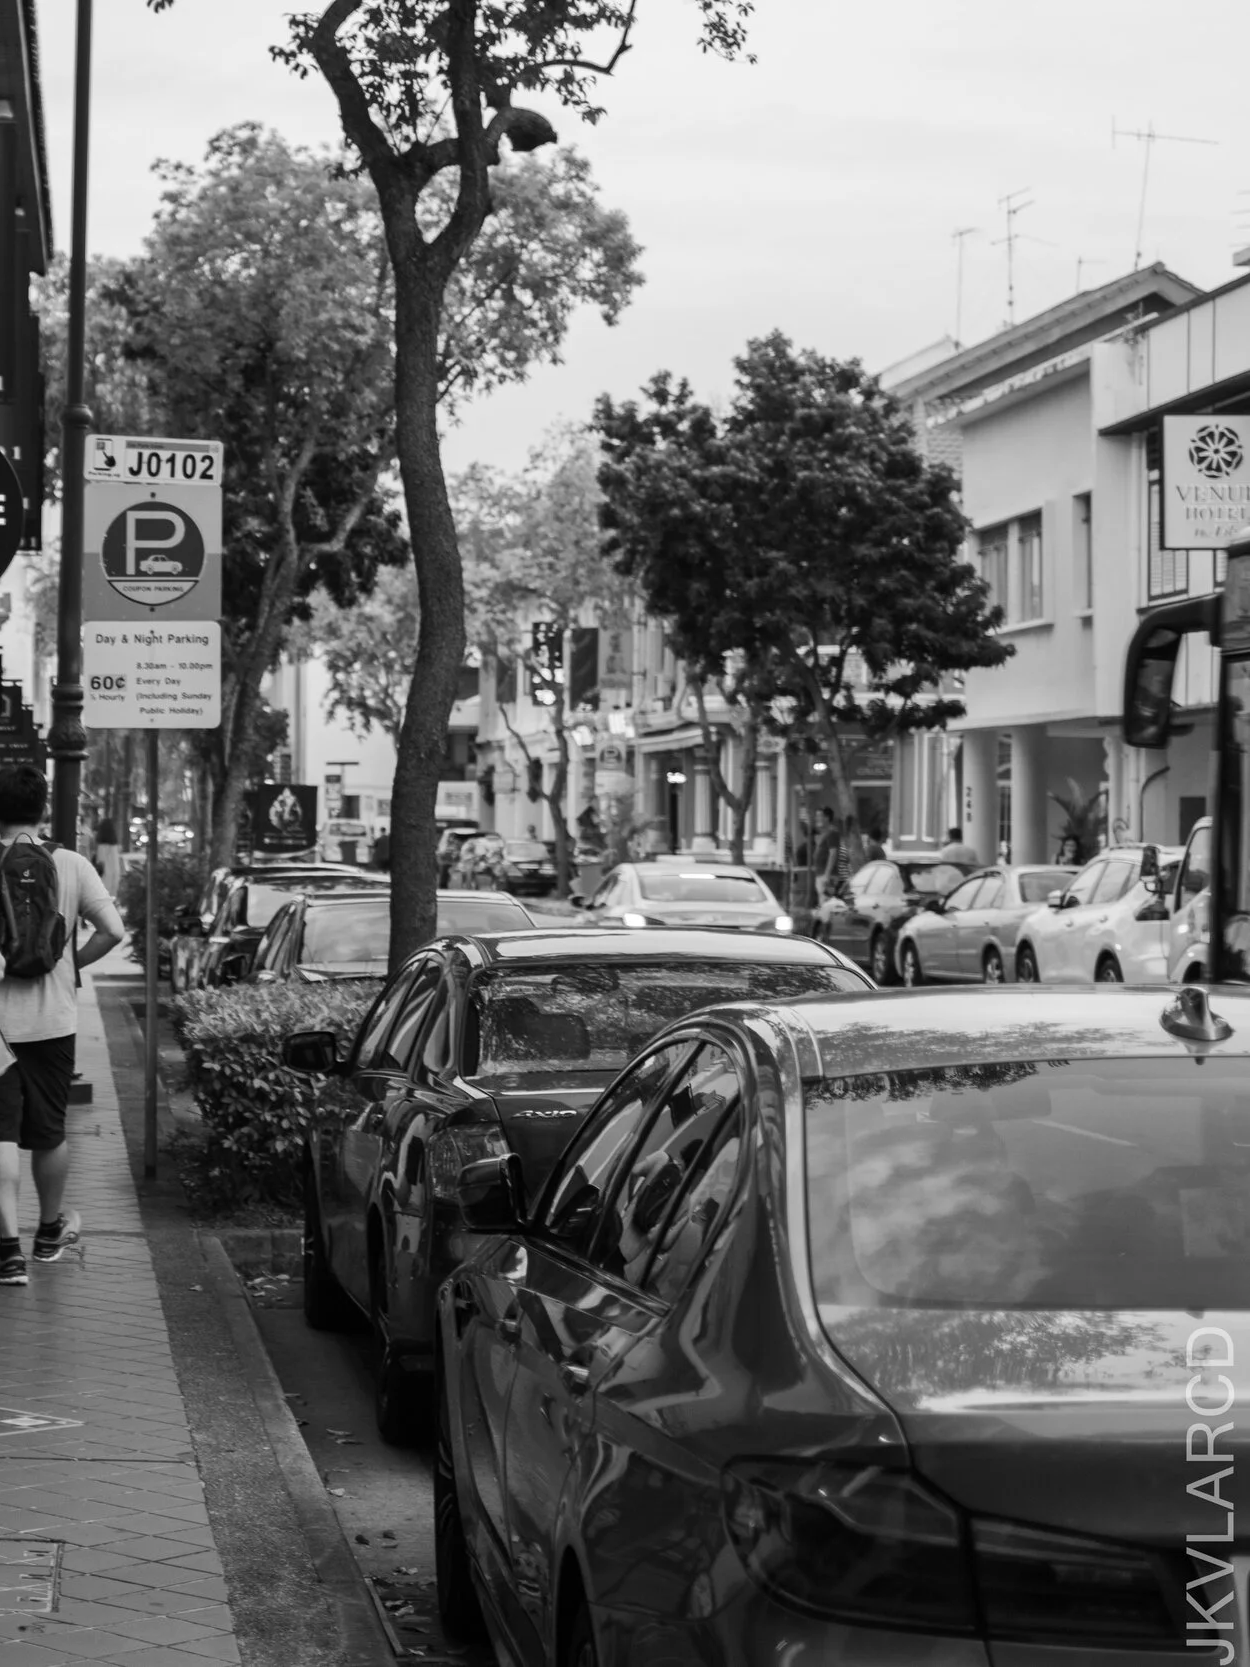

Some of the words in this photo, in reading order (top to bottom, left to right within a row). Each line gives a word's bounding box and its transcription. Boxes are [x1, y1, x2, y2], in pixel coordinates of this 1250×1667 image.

[128, 452, 215, 480] J0102
[126, 511, 185, 575] P
[96, 634, 116, 646] Day
[121, 634, 129, 644] &
[134, 634, 163, 646] Night
[168, 634, 209, 646] Parking
[90, 675, 126, 691] 60¢
[136, 678, 162, 687] Every
[165, 678, 181, 687] Day
[99, 694, 126, 702] Hourly
[181, 692, 212, 702] Sunday
